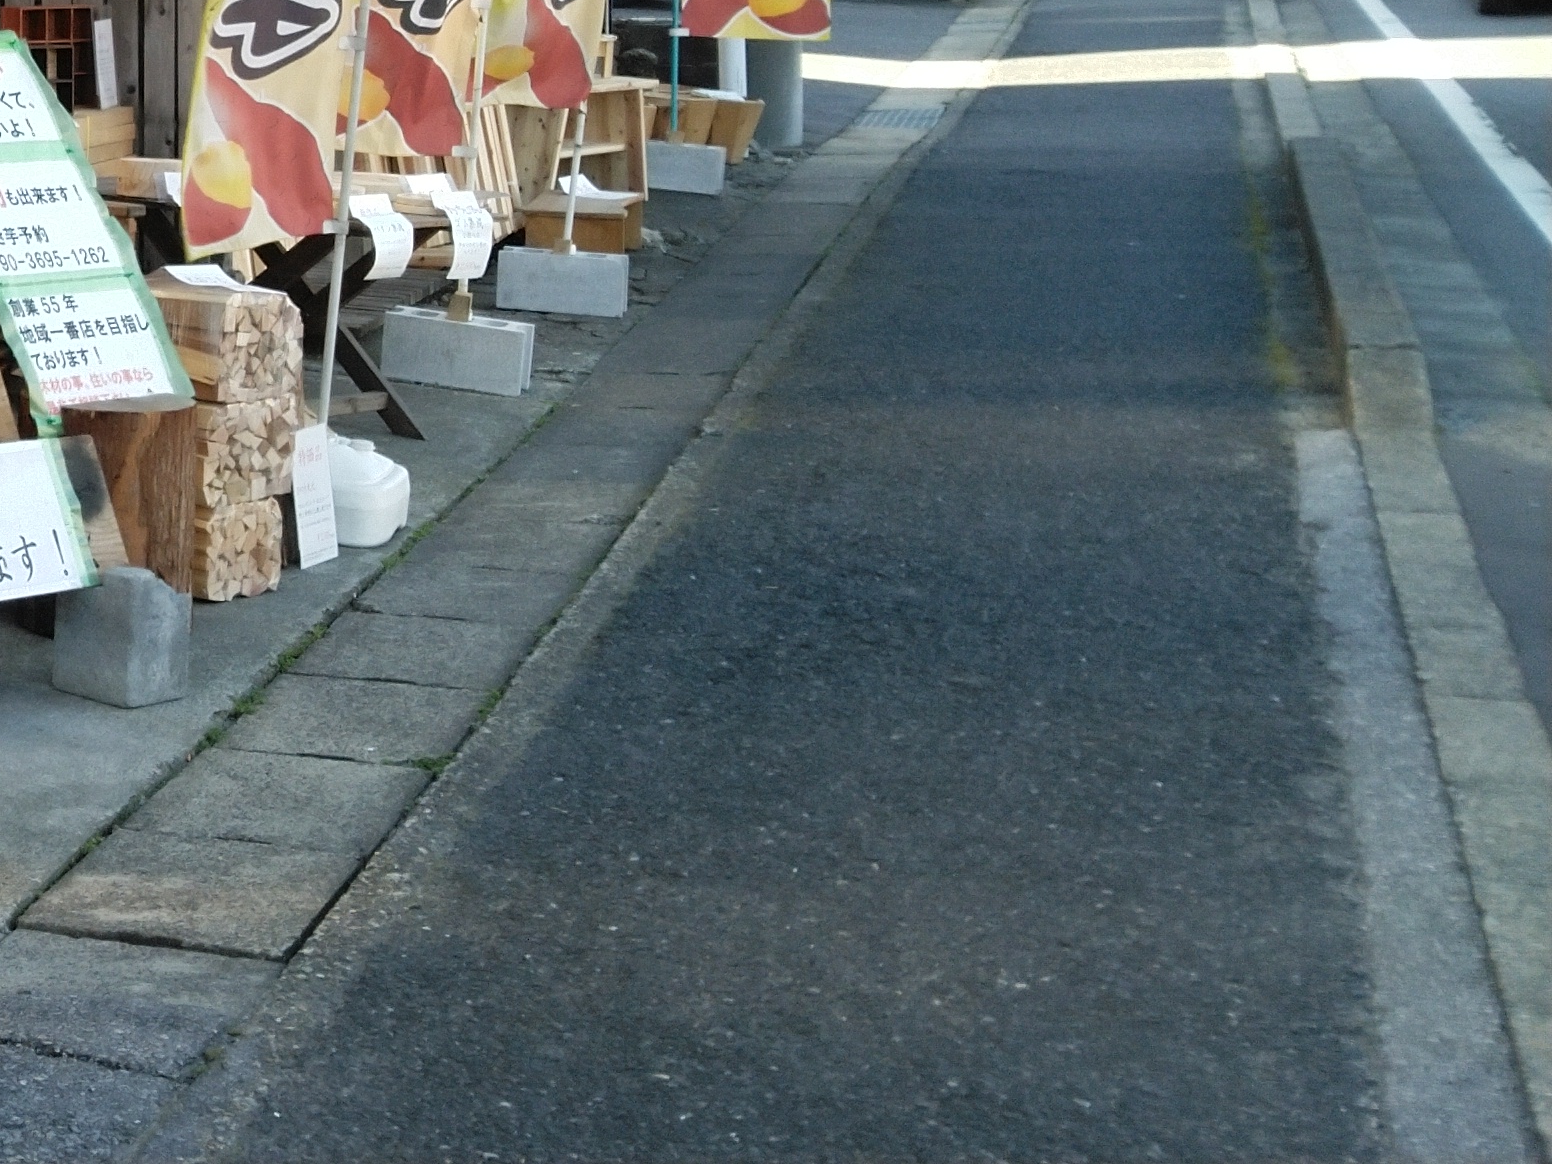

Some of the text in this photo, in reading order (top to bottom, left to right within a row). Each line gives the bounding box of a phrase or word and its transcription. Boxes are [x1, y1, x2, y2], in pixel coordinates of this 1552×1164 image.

[18, 313, 150, 344] 地域一番店を目指し
[30, 346, 103, 372] ております！
